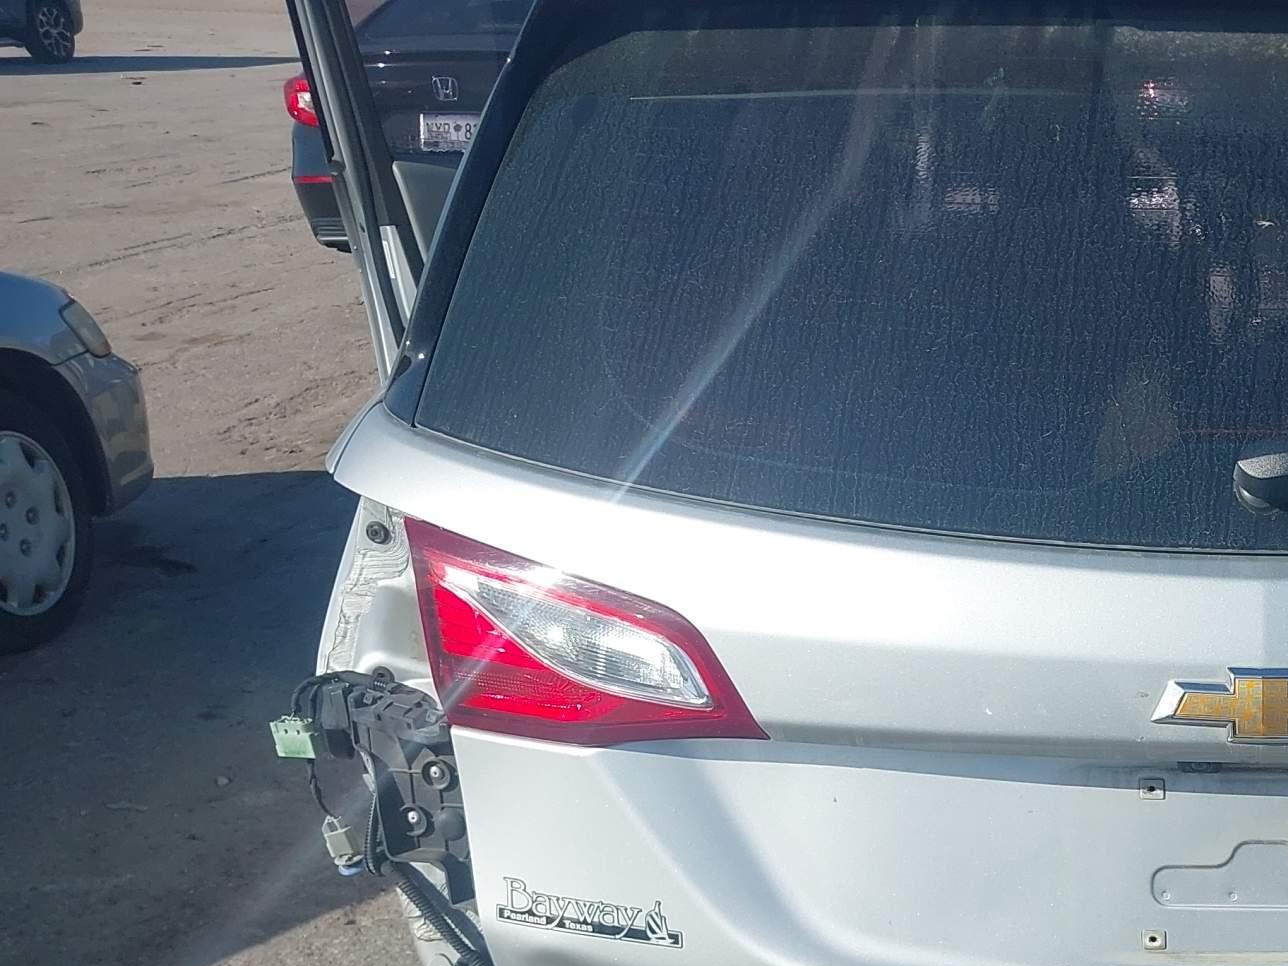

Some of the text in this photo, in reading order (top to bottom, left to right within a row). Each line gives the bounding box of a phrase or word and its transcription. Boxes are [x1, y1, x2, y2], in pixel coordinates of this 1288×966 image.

[502, 876, 643, 939] Bayway
[503, 910, 593, 933] Pearland Texas
